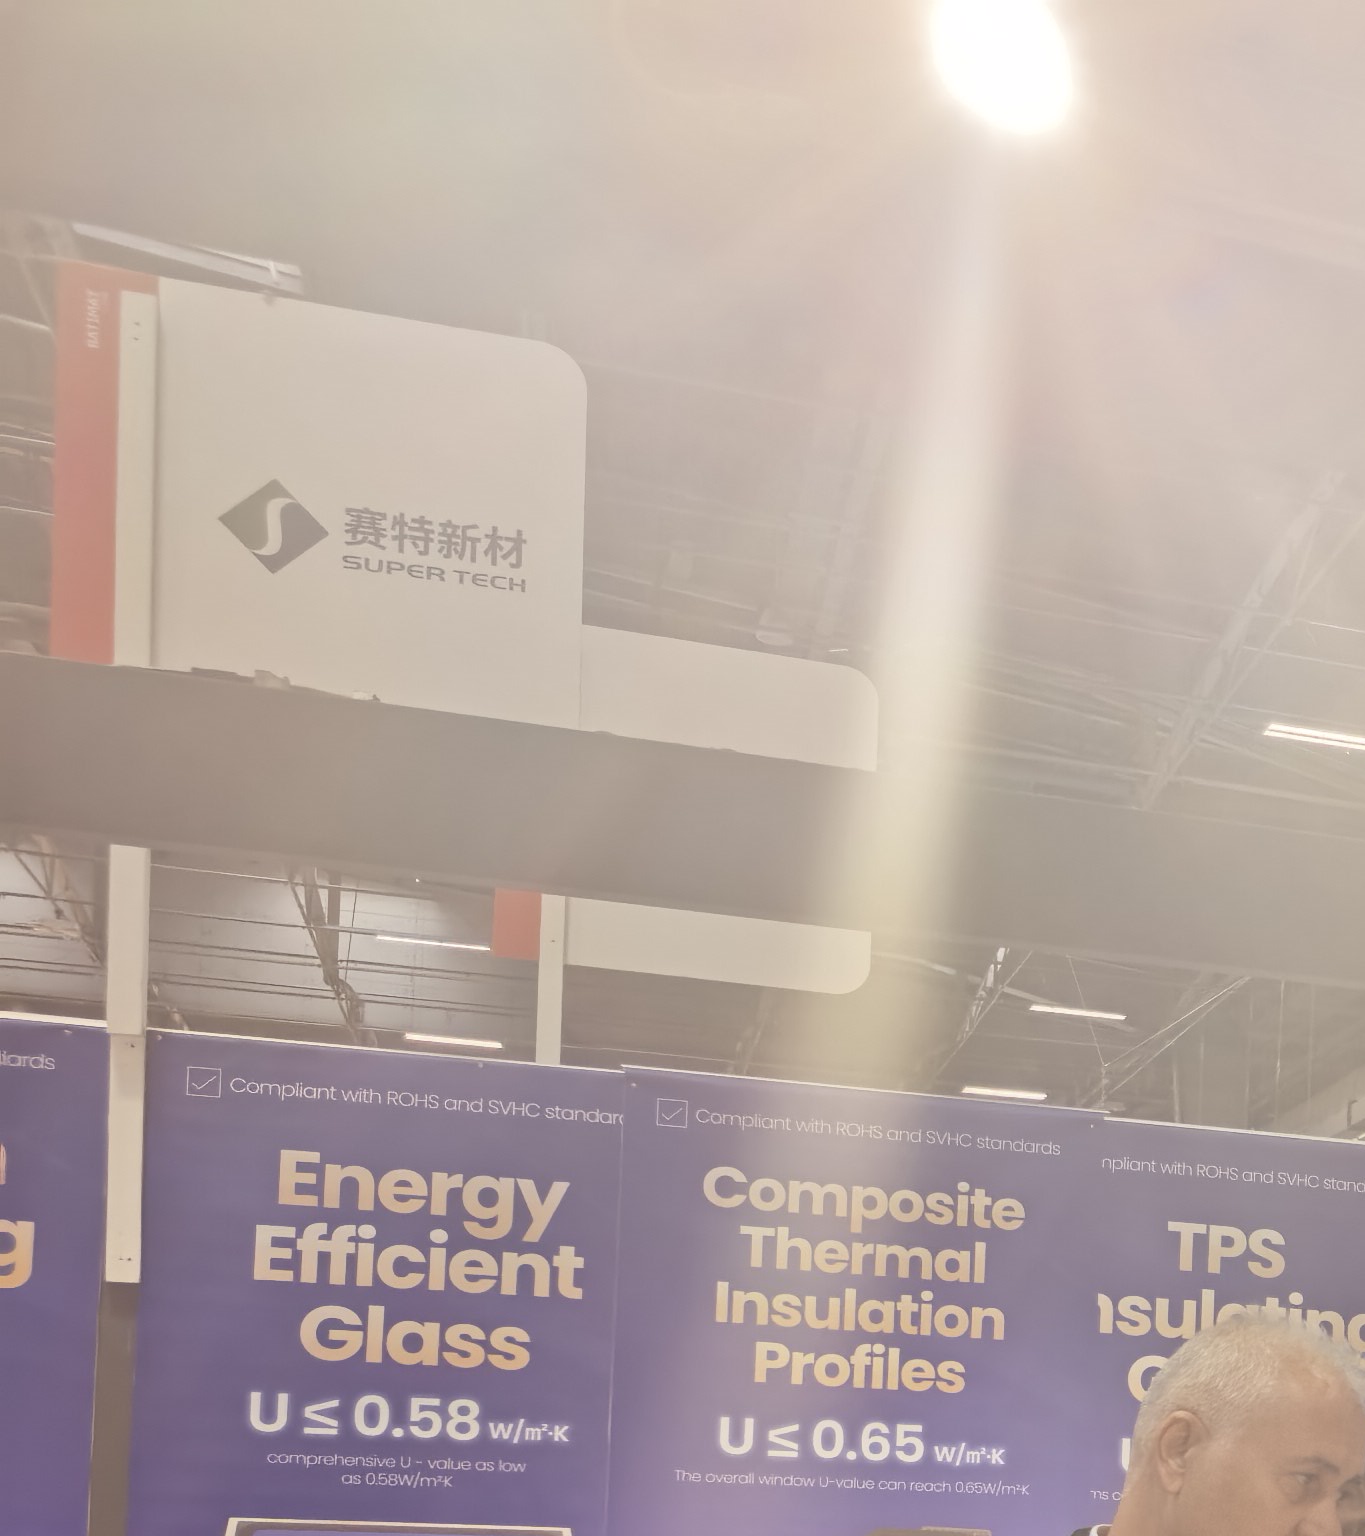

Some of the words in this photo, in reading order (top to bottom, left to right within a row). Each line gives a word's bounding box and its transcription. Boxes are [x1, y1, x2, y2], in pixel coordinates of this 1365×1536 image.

[344, 507, 528, 569] 赛特新材
[342, 555, 446, 582] SUPER
[452, 569, 527, 592] TECH
[230, 1077, 338, 1101] Compliant
[341, 1087, 382, 1105] with
[387, 1091, 439, 1110] ROHS
[444, 1098, 483, 1113] and
[488, 1102, 540, 1119] SVHC
[695, 1109, 792, 1131] Compliant
[796, 1119, 832, 1135] with
[836, 1122, 883, 1140] ROHS
[887, 1128, 922, 1144] and
[926, 1130, 973, 1148] SVHC
[976, 1135, 1062, 1156] standards
[278, 1149, 571, 1243] Energy
[703, 1166, 1026, 1234] Composite
[1160, 1161, 1193, 1176] with
[1197, 1163, 1240, 1181] ROHS
[1242, 1170, 1275, 1184] and
[1278, 1172, 1320, 1188] SVHC
[254, 1222, 585, 1300] Efficient
[740, 1225, 987, 1284] Thermal
[1167, 1221, 1286, 1279] TPS
[715, 1281, 1006, 1341] Insulation
[299, 1305, 532, 1371] Glass
[754, 1341, 966, 1394] Profiles
[250, 1392, 289, 1433] U
[354, 1394, 480, 1441] 0.58
[720, 1417, 754, 1455] U
[812, 1420, 924, 1463] 0.65
[266, 1453, 396, 1467] comprehensive
[400, 1456, 411, 1468] U
[427, 1458, 472, 1470] value
[475, 1461, 495, 1471] as
[498, 1460, 527, 1473] low
[341, 1474, 361, 1486] as
[674, 1470, 702, 1482] The
[705, 1471, 755, 1484] overall
[758, 1472, 816, 1487] window
[819, 1476, 875, 1490] U-value
[878, 1479, 906, 1491] can
[909, 1480, 952, 1493] reach
